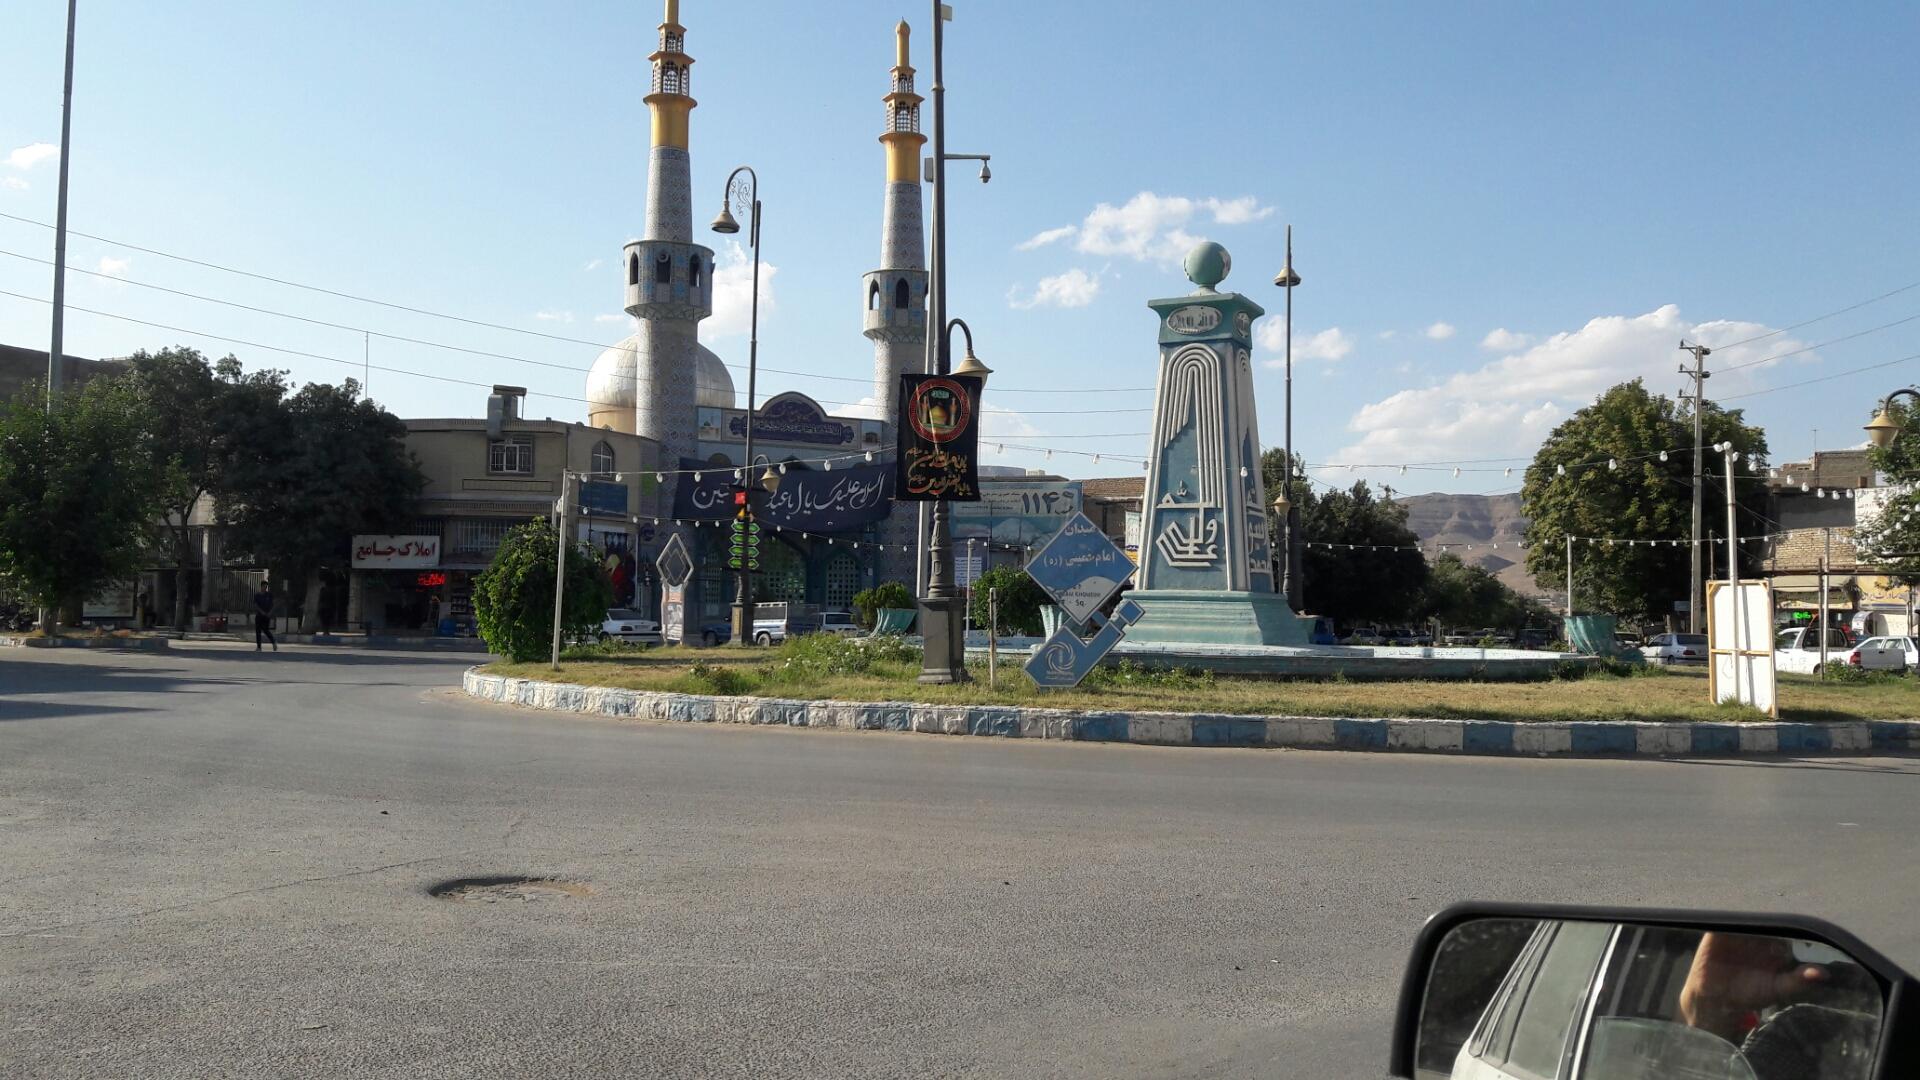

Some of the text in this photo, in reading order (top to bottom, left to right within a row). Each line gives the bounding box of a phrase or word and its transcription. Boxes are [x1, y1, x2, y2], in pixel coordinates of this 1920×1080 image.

[813, 475, 859, 512] علیک
[850, 471, 887, 510] السلام
[1064, 522, 1098, 537] میدان
[356, 541, 436, 561] املاک جامع
[1066, 549, 1095, 567] خمینی
[1095, 549, 1116, 568] امام
